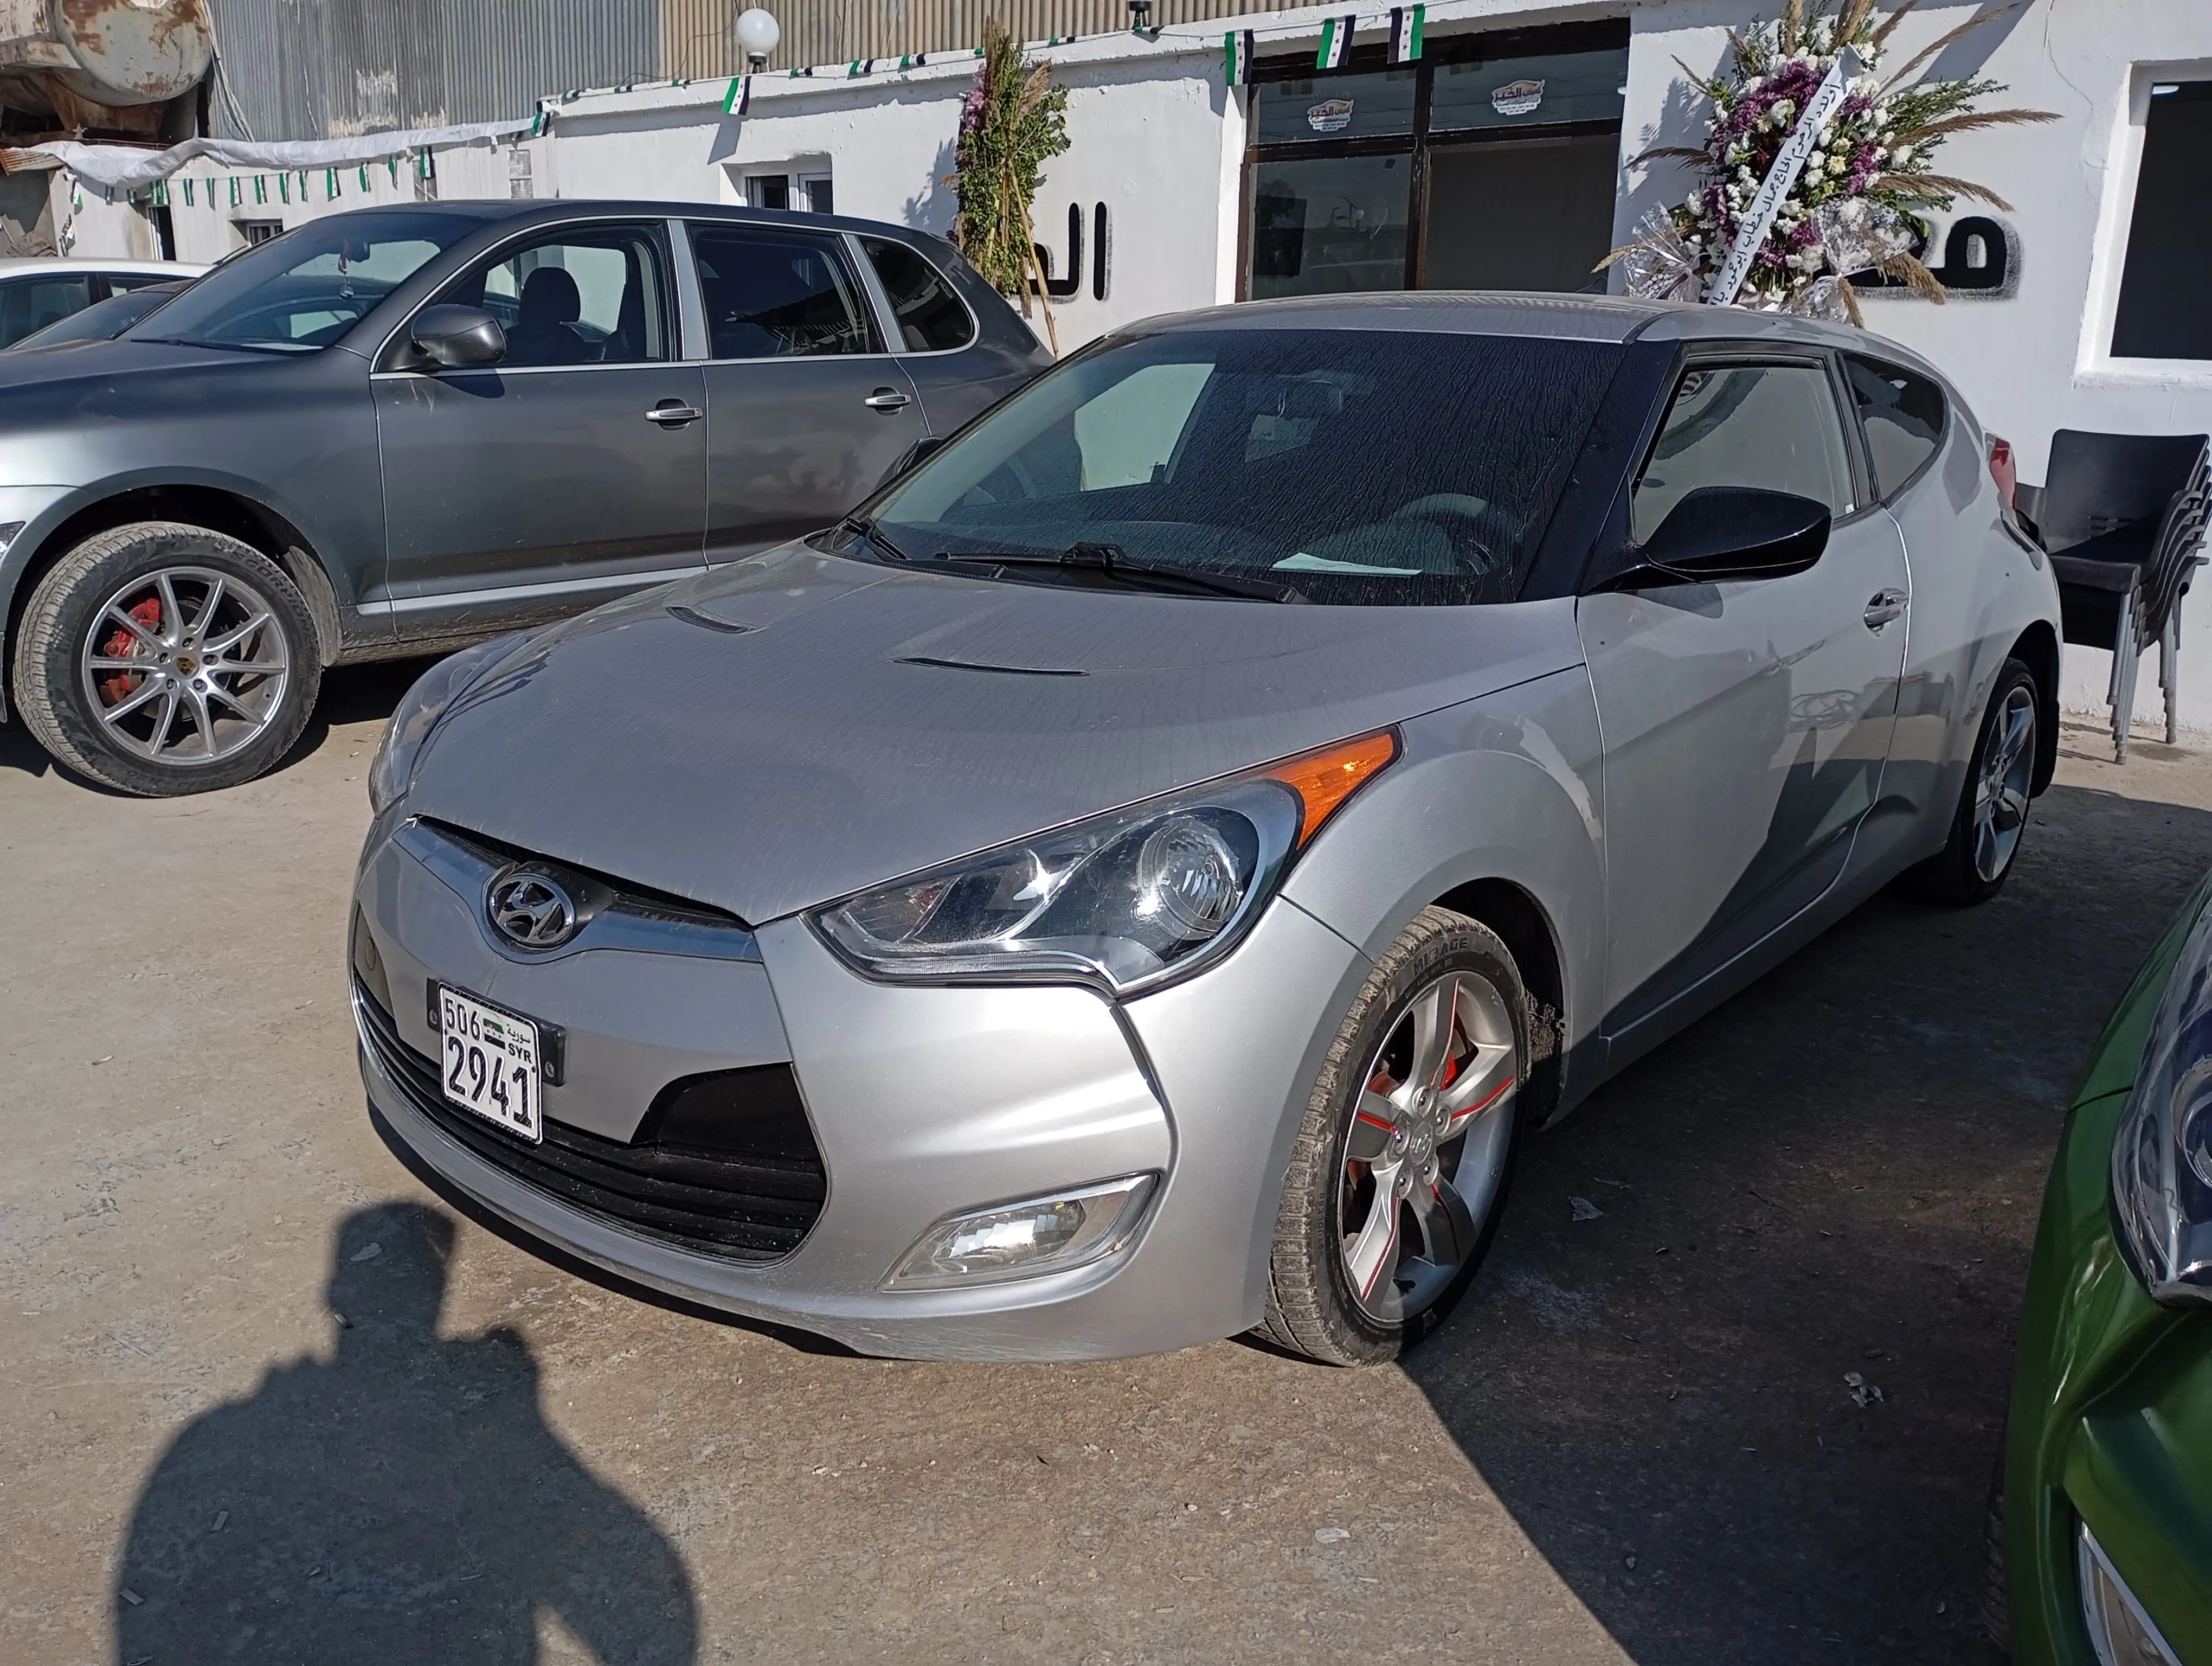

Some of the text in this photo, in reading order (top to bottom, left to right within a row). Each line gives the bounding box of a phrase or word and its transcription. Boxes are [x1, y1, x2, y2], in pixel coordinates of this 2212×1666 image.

[1494, 86, 1522, 103] الخير
[1816, 84, 1841, 118] أولاد
[1310, 106, 1334, 120] الخير
[1792, 117, 1815, 160] المرحوم
[1774, 157, 1792, 185] الحاج
[1762, 182, 1779, 212] جمال
[1742, 212, 1763, 247] خطاب
[1732, 249, 1747, 270] أبو
[1412, 935, 1469, 978] MIRAGE
[445, 997, 483, 1041] 506
[506, 1023, 531, 1044] سورية
[508, 1042, 532, 1064] SYR
[448, 1035, 535, 1130] 2941
